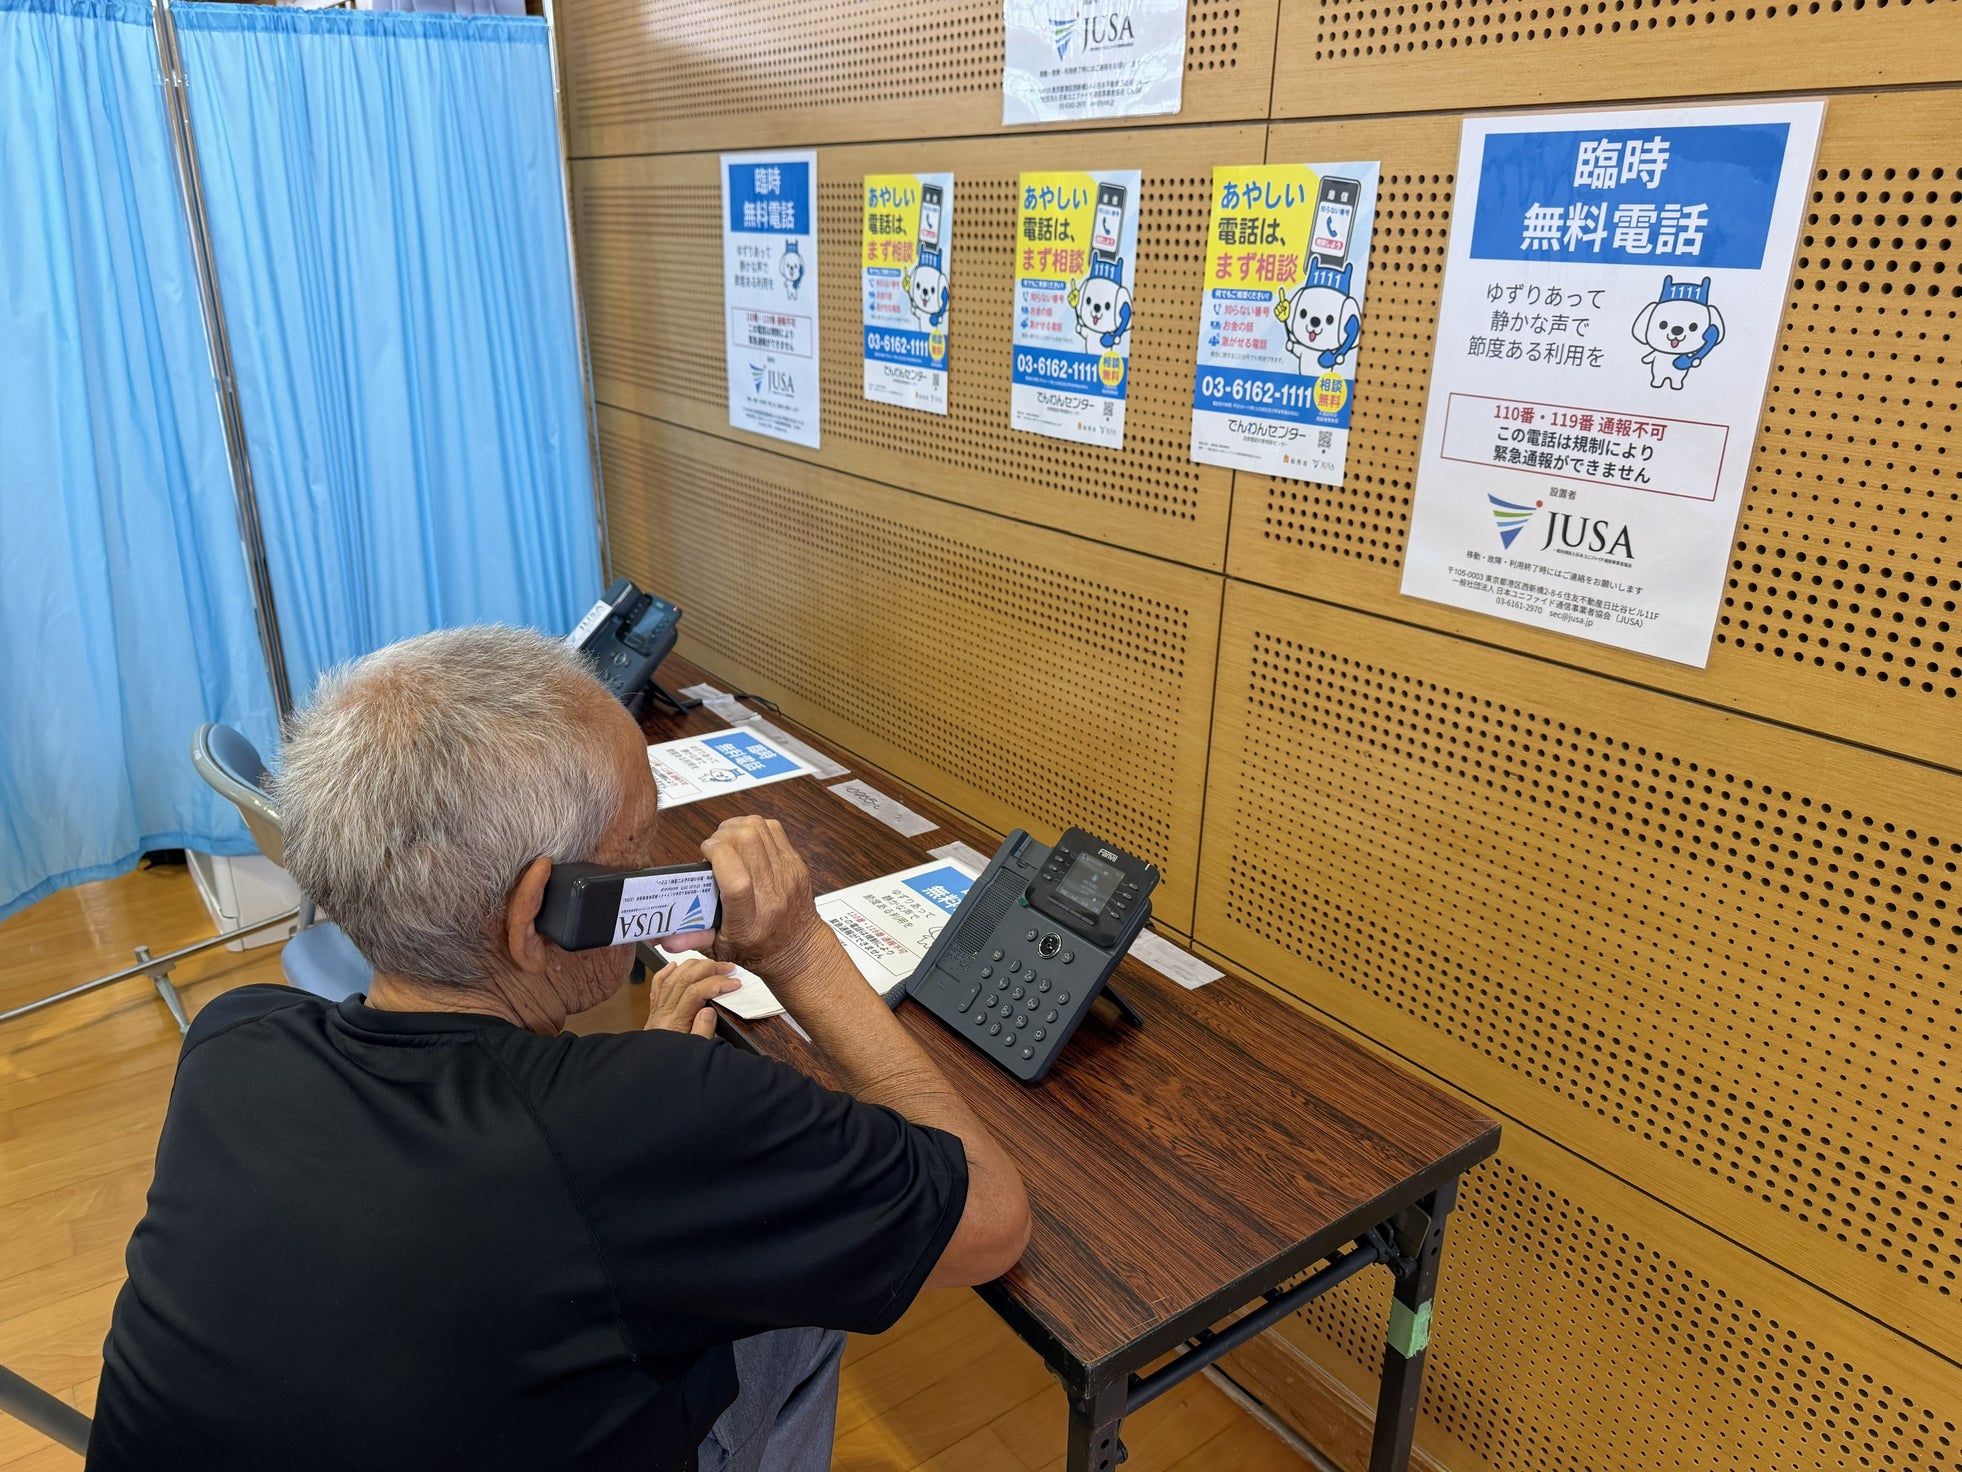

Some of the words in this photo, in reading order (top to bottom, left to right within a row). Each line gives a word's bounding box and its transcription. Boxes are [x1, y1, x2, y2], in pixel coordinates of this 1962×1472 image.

[1081, 12, 1135, 55] JUSA
[1573, 135, 1670, 190] 臨時
[754, 166, 781, 195] 臨時
[868, 186, 915, 208] あやしい
[1024, 185, 1088, 211] あやしい
[1220, 181, 1306, 210] あやしい
[743, 199, 795, 229] 無料電話
[868, 213, 907, 236] 電話は、
[1023, 217, 1075, 242] 電話は、
[1218, 216, 1286, 246] 電話は、
[1519, 201, 1710, 256] 無料電話
[868, 240, 914, 264] まず相談
[1023, 247, 1085, 274] まず相談
[1094, 263, 1115, 278] 1111
[1215, 252, 1299, 283] まず相談
[1312, 270, 1341, 288] 1111
[1486, 283, 1606, 310] ゆずりあって
[1669, 285, 1701, 300] 1111
[1225, 304, 1270, 317] 知らない番号
[1490, 310, 1590, 338] 静かな声で
[1223, 321, 1254, 333] お金の話
[867, 332, 929, 357] 03-6162-1111
[1222, 336, 1268, 350] 急がせる電話
[1467, 335, 1605, 368] 節度ある利用を
[1016, 353, 1098, 383] 03-6162-1111
[767, 370, 795, 394] JUSA
[1202, 375, 1313, 408] 03-6162-1111
[1319, 377, 1343, 394] 相談
[1318, 393, 1341, 408] 無料
[1227, 418, 1306, 441] でんわんセンター
[1494, 404, 1595, 431] 110番・119番
[1598, 416, 1668, 442] 通報不可
[1496, 425, 1655, 462] この電話は規制により
[1493, 444, 1652, 485] 緊急通報ができません
[1549, 487, 1577, 500] 設置者
[1540, 511, 1635, 560] JUSA
[1466, 550, 1644, 596] 移動・故障・利用終了時にはご連絡をお願いします
[1496, 597, 1543, 615] 03-6161-2970
[1549, 610, 1594, 628] sec@jusa.jp
[715, 743, 766, 771] 無料電話
[746, 743, 777, 760] 臨時
[1098, 848, 1118, 863] Fanvil
[881, 895, 920, 920] 静かな声で
[892, 888, 936, 919] ゆずりあって
[922, 885, 963, 912] 無料
[620, 901, 676, 939] JUSA
